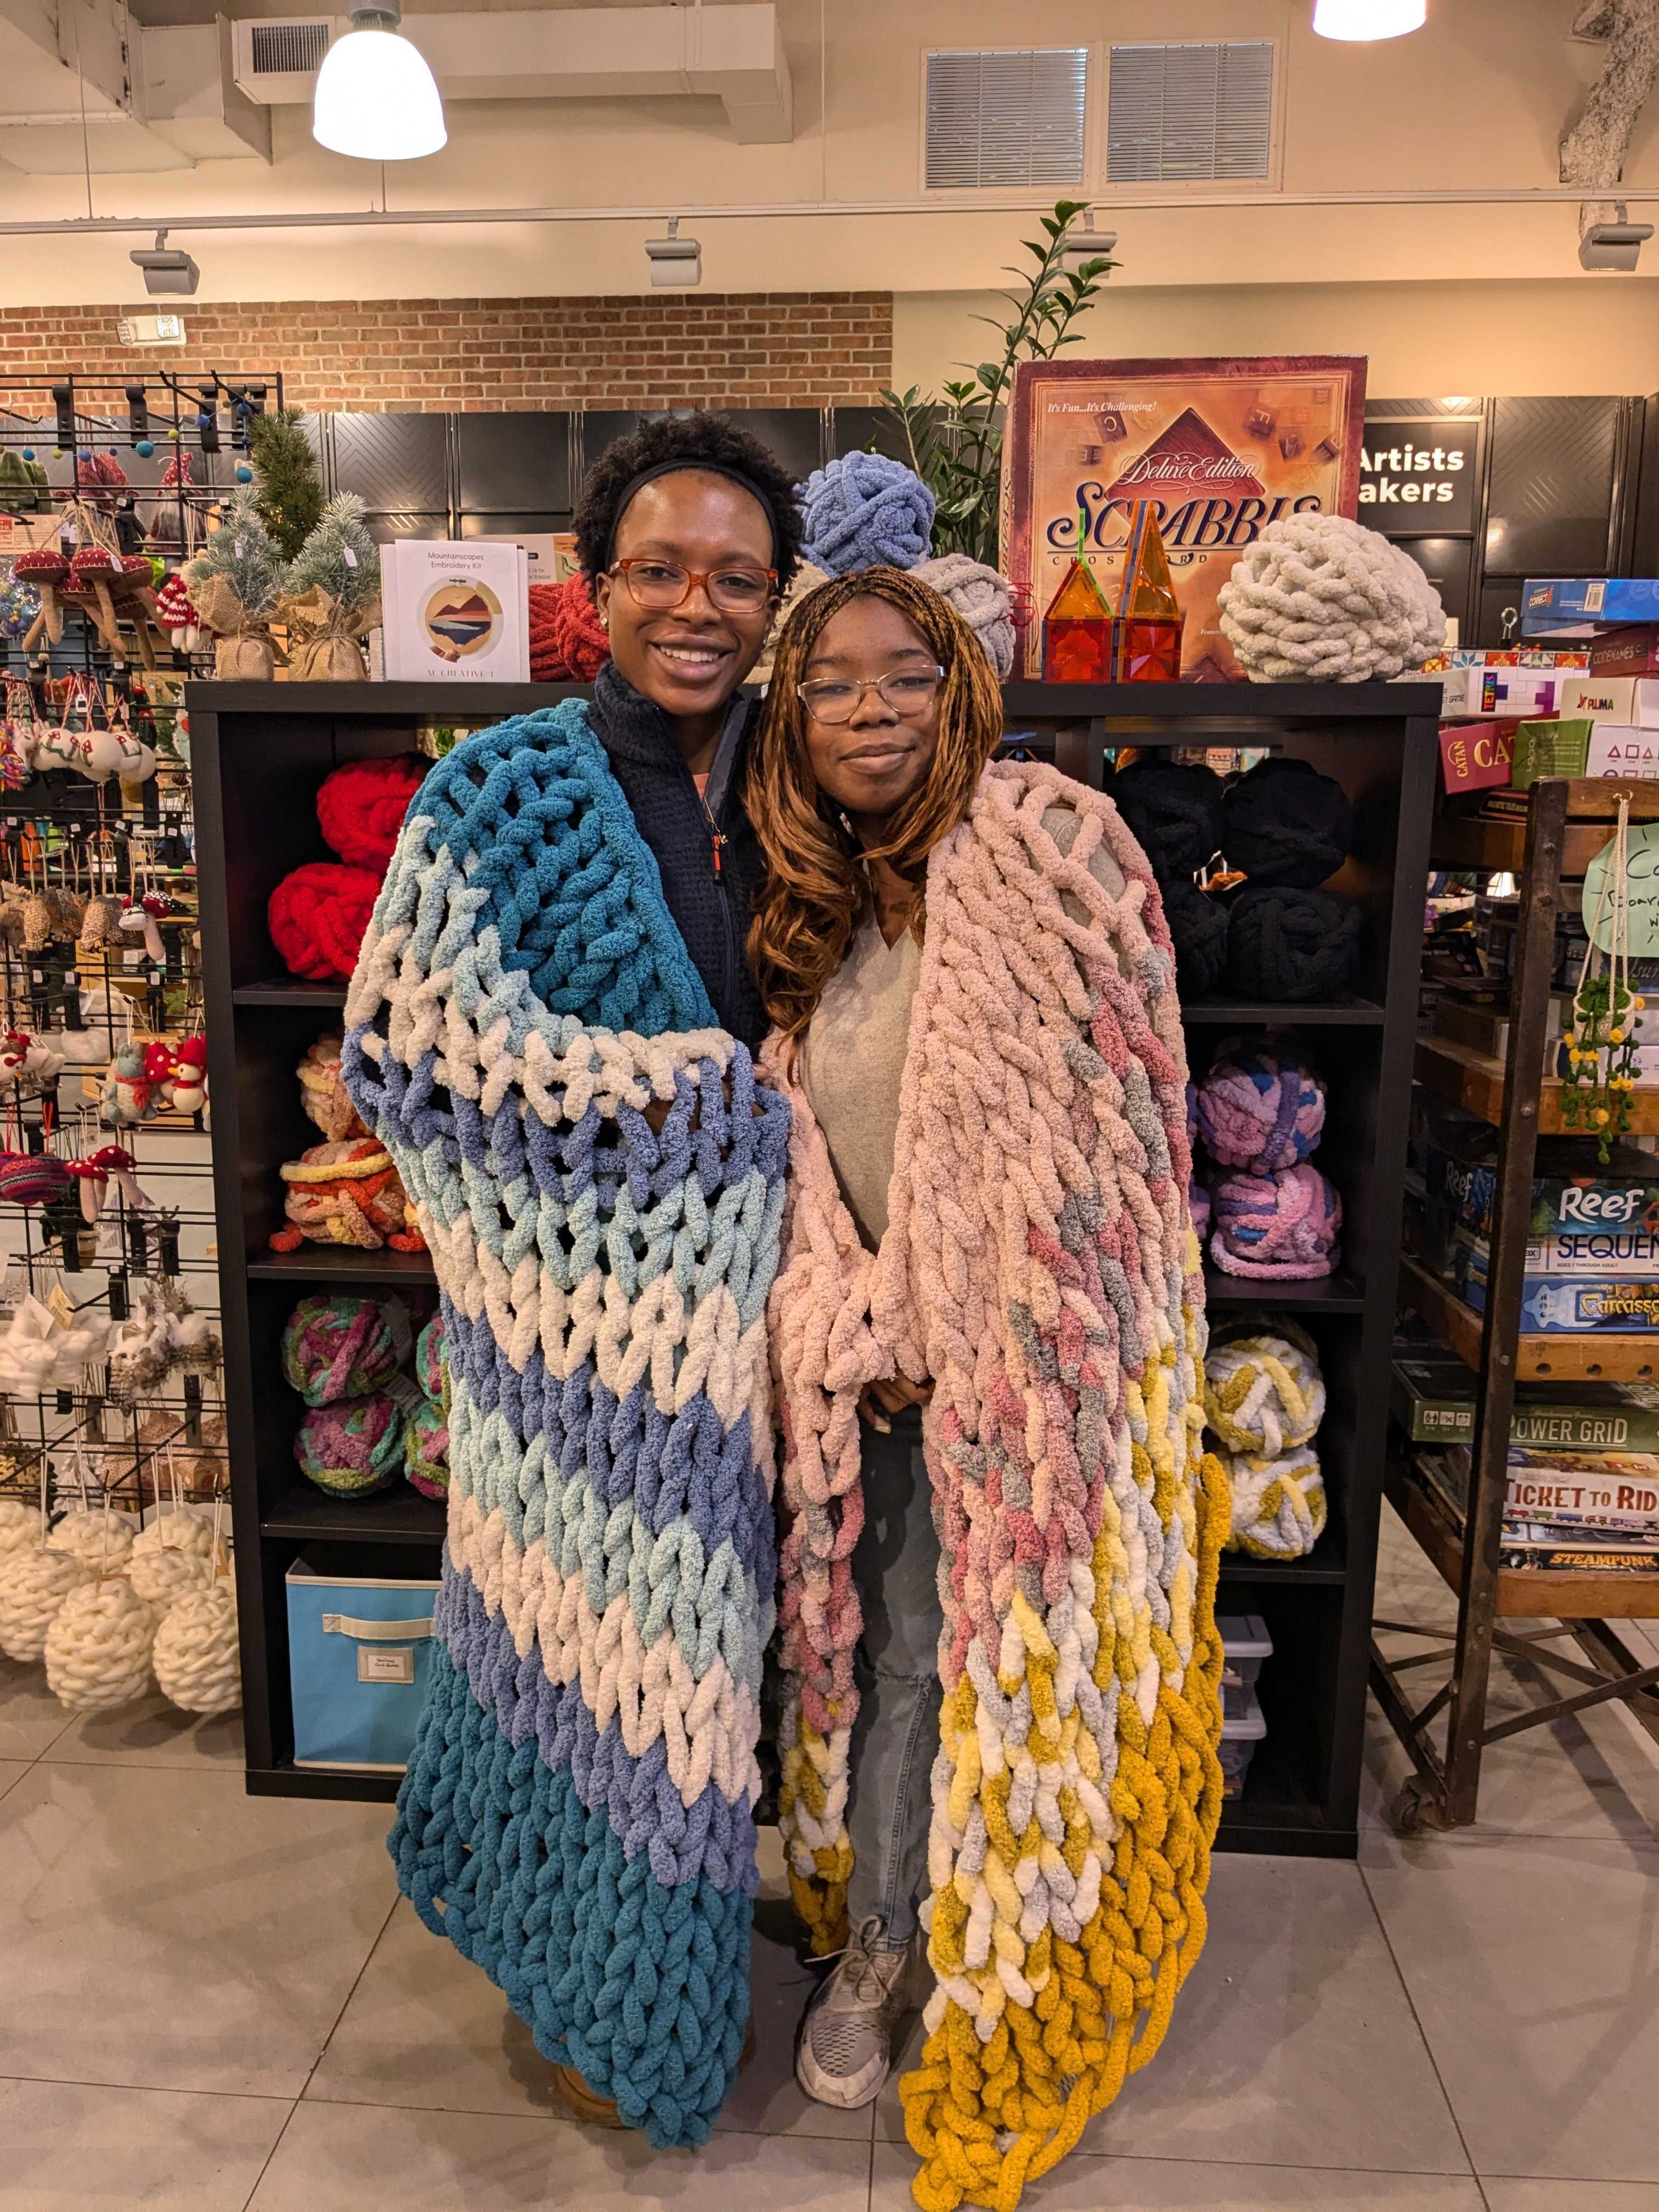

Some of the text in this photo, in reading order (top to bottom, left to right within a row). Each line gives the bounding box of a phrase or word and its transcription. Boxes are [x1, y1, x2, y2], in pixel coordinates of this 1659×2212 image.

[1048, 404, 1059, 413] It's
[1101, 402, 1157, 412] Challenging!
[1117, 453, 1256, 485] Deluxe Edition
[1360, 444, 1464, 472] Artists
[1358, 477, 1453, 503] akers
[428, 552, 484, 560] Mountainscapes
[431, 561, 470, 569] Embroidery
[1593, 646, 1633, 665] CODENAMES
[1449, 695, 1464, 703] GAME
[1484, 675, 1496, 709] TETRIS
[1454, 741, 1469, 777] CATAN
[1446, 1161, 1473, 1201] Reef
[1559, 1187, 1644, 1223] Reef
[1580, 1418, 1628, 1443] GRID
[1590, 1491, 1611, 1506] TO
[1549, 1553, 1657, 1567] STEAMPUNK
